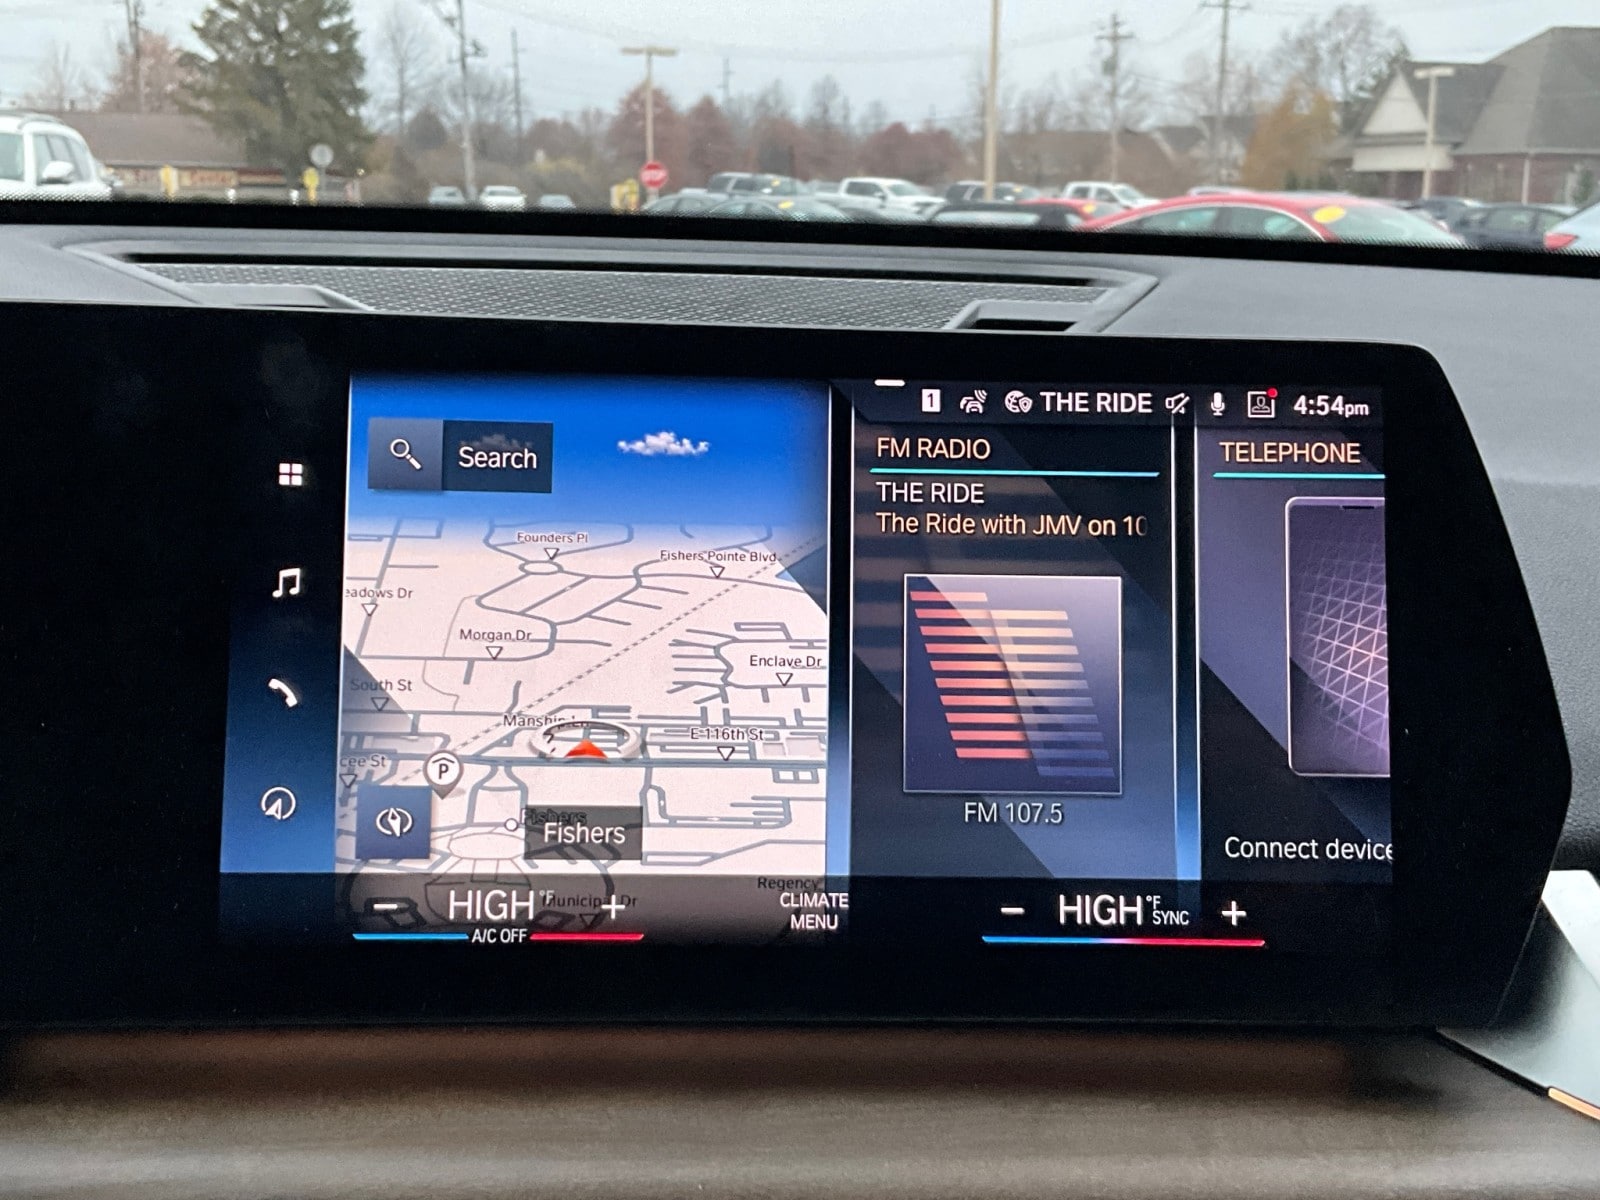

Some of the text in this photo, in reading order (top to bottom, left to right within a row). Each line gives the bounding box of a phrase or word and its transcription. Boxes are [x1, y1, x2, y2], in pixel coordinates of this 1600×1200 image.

[1040, 391, 1153, 413] THE RIDE
[1293, 395, 1369, 418] 4:54pm
[877, 437, 991, 460] FM RADIO
[1219, 441, 1361, 464] TELEPHONE
[458, 446, 538, 470] Search
[876, 481, 985, 504] THE RIDE
[876, 512, 919, 534] The
[926, 513, 976, 535] Ride
[982, 513, 1027, 536] with
[1032, 515, 1081, 536] JMV
[1087, 518, 1116, 537] on
[517, 532, 574, 544] Founders
[660, 550, 777, 564] Fishers Pointe Blvd
[399, 587, 413, 599] Dr
[459, 628, 532, 643] Morgan Dr
[749, 654, 822, 668] Enclave Dr
[350, 678, 412, 692] South St
[690, 727, 763, 741] E 116th St
[370, 754, 386, 768] St
[965, 801, 1063, 824] FM 107.5
[544, 822, 626, 844] Fishers
[1224, 836, 1318, 859] Connect
[757, 876, 820, 891] Regency
[449, 889, 534, 920] HIGH
[620, 894, 636, 907] Dr
[780, 892, 849, 908] CLIMATE
[1058, 895, 1143, 926] HIGH
[1152, 910, 1190, 926] SYNC
[790, 913, 839, 930] MENU
[471, 928, 529, 944] A/C OFF
